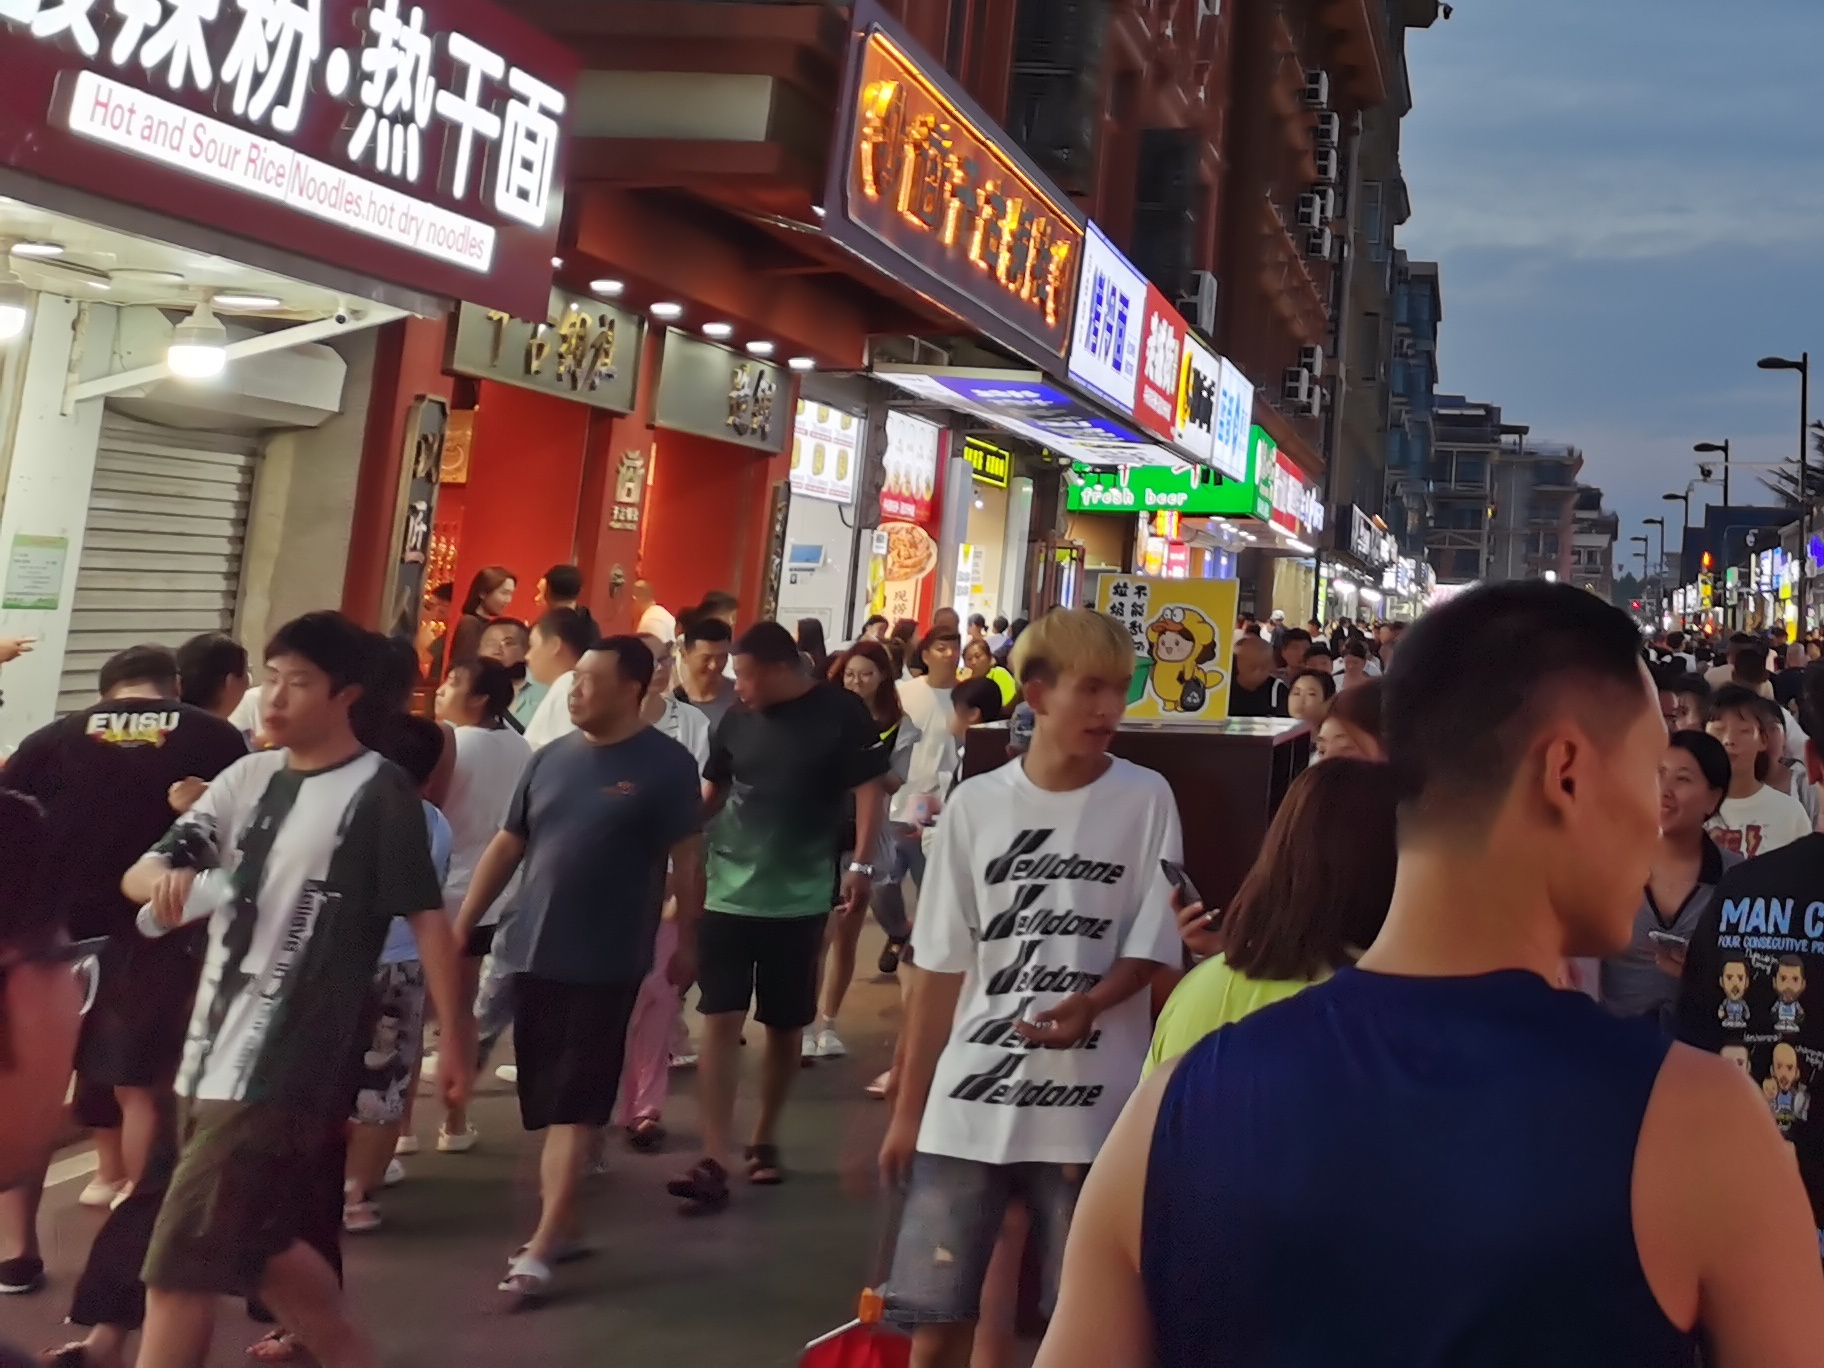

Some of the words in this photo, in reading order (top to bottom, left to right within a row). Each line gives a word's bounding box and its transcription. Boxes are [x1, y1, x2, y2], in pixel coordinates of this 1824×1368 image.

[90, 84, 135, 135] Hot
[140, 117, 184, 151] and
[190, 123, 240, 171] Sour
[244, 143, 286, 188] Rice
[399, 204, 424, 248] dry
[426, 218, 484, 260] noodles
[1081, 487, 1135, 506] fresh
[1145, 488, 1188, 505] beer
[86, 711, 180, 735] EVISU
[1719, 896, 1795, 935] MAN
[1743, 936, 1808, 953] CONSECUTIVE
